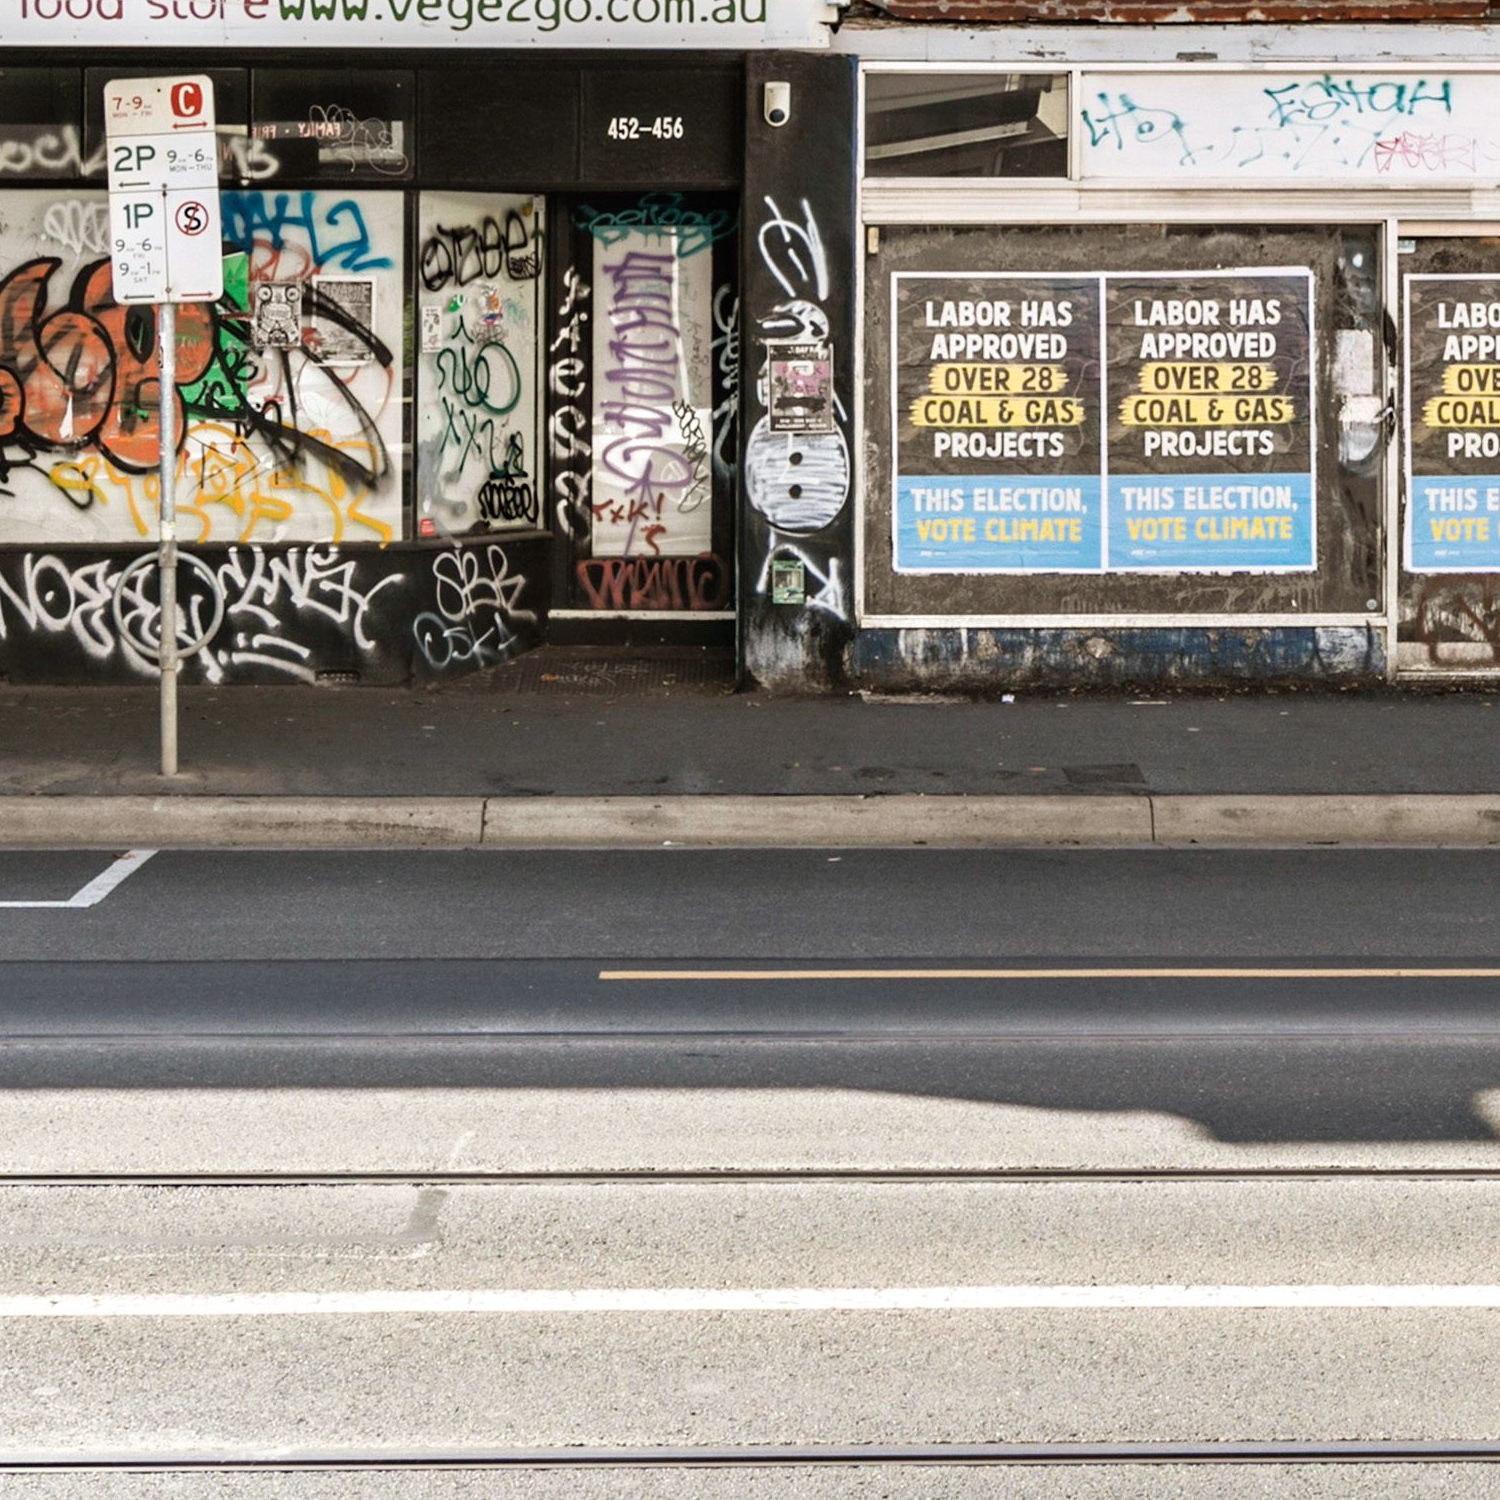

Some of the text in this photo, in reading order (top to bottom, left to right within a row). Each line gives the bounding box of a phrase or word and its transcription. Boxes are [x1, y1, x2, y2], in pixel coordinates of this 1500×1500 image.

[607, 117, 685, 140] 452-456
[113, 145, 156, 172] 2P
[122, 202, 154, 230] 1P
[925, 300, 1073, 328] LABOR HAS
[1134, 299, 1282, 327] LABOR HAS
[930, 333, 1067, 361] APPROVED
[1139, 332, 1276, 360] APPROVED
[944, 365, 1054, 392] OVER 28
[1154, 364, 1263, 390] OVER 28
[923, 399, 1075, 424] COAL & GAS
[1133, 397, 1284, 423] COAL & GAS
[1436, 400, 1500, 425] COAL
[934, 432, 1064, 458] PROJECTS
[1144, 430, 1274, 457] PROJECTS
[911, 487, 1088, 516] THIS ELECTION,
[1121, 484, 1298, 514] THIS ELECTION,
[1424, 488, 1477, 512] THIS
[916, 518, 1082, 542] VOTE CLIMATE
[1127, 515, 1293, 540] VOTE CLIMATE
[1430, 518, 1488, 542] VOTE
